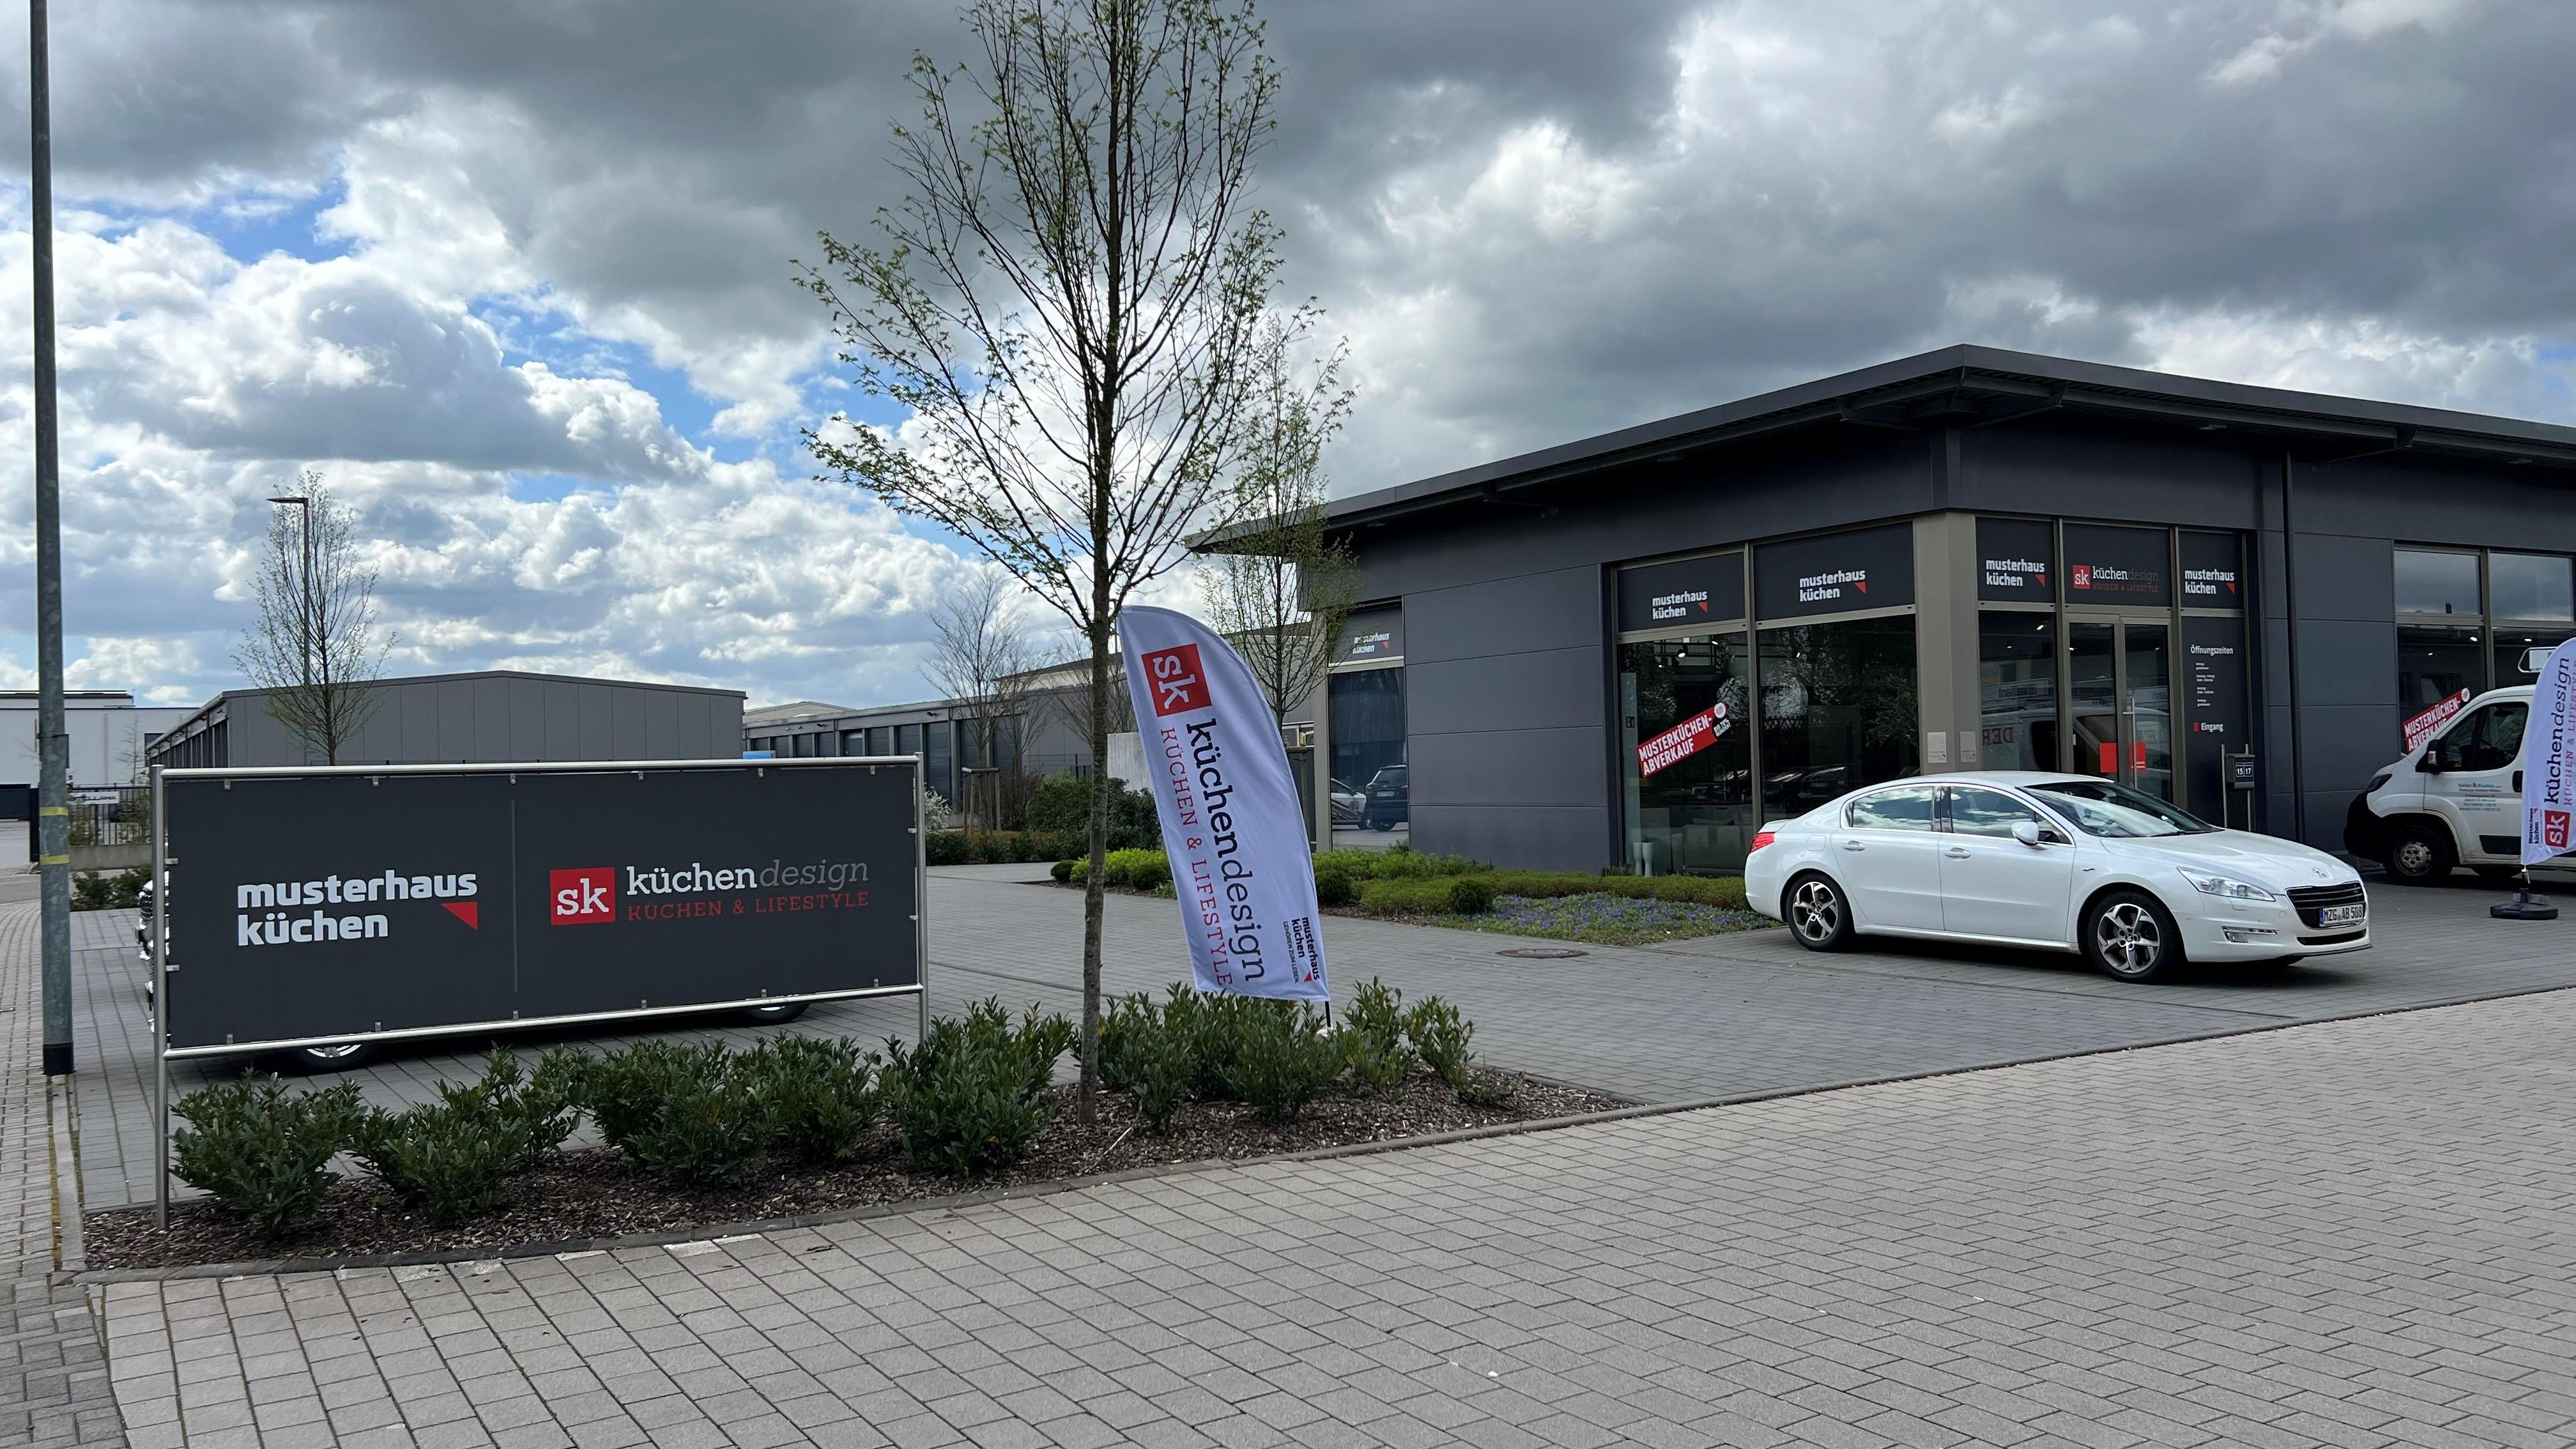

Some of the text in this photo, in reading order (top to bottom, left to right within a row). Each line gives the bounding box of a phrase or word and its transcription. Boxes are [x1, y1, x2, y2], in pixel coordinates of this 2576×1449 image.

[1799, 569, 1866, 588] musterhaus
[1986, 558, 2045, 573] musterhaus
[1986, 572, 2023, 587] küchen
[2074, 565, 2158, 585] sk küchendesign
[2184, 569, 2235, 583] musterhaus
[1652, 590, 1708, 607] musterhaus
[1799, 586, 1840, 602] küchen
[2185, 581, 2216, 595] küchen
[1652, 605, 1687, 620] küchen
[2190, 644, 2234, 656] Öffnungszeiten
[1153, 654, 1197, 710] sk
[2201, 722, 2223, 733] Eingang
[2404, 697, 2460, 738] MUSTERKÜCHEN-
[2544, 658, 2572, 805] küchendesign
[1638, 714, 1712, 762] MUSTERKÜCHEN-
[1643, 737, 1694, 775] ABVERKAUF
[2546, 815, 2566, 844] sk
[1160, 726, 1233, 986] KÜCHEN & LIFESTYLE
[1186, 718, 1266, 982] küchendesign
[238, 869, 478, 908] musterhaus
[556, 859, 869, 916] sk küchendesign
[627, 891, 870, 921] KÜCHEN & LIFESTYLE
[2342, 907, 2350, 920] AB
[238, 910, 388, 947] küchen
[1291, 918, 1305, 958] küchen
[1301, 916, 1320, 980] musterhaus
